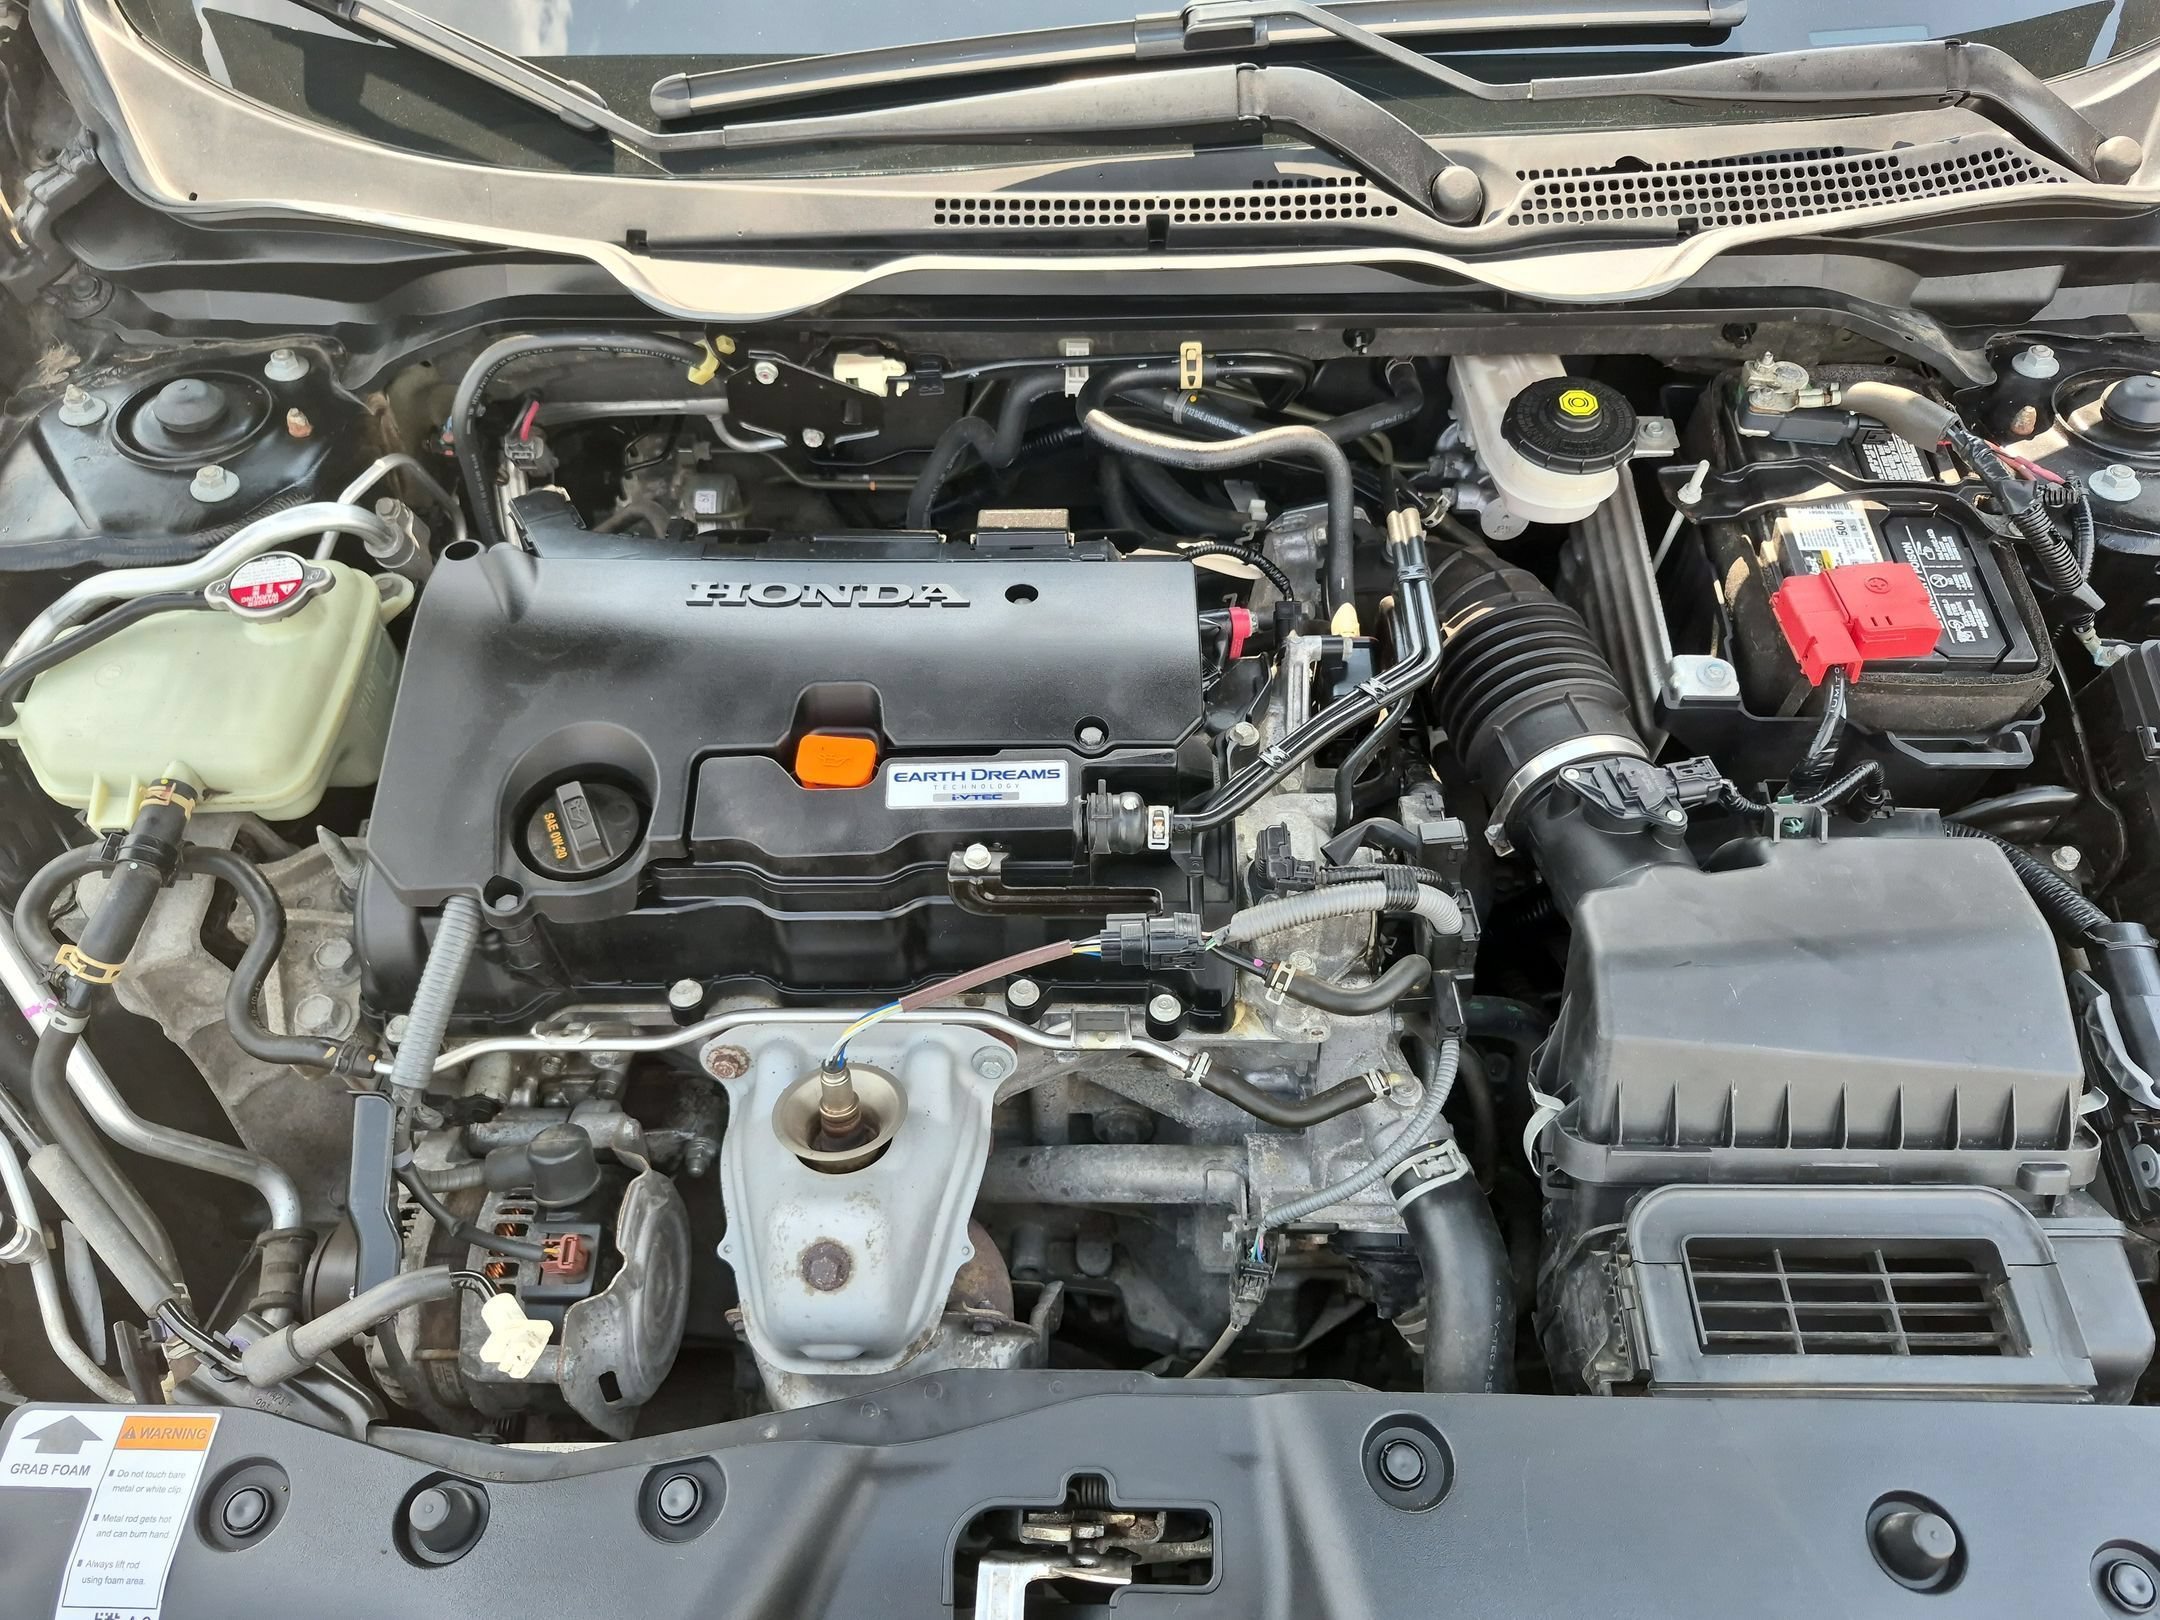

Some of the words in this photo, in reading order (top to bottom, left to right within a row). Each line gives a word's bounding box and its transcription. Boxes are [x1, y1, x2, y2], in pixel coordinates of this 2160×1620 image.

[1834, 520, 1848, 536] 500
[1901, 541, 1923, 574] POISON
[686, 582, 970, 608] HONDA
[894, 771, 965, 783] EARTH
[971, 768, 1060, 781] DREAMS
[543, 812, 559, 832] SAE
[549, 831, 568, 859] 0W-20
[140, 1427, 207, 1440] WARNING
[10, 1463, 47, 1475] GRAB
[51, 1464, 91, 1476] FOAM
[117, 1469, 130, 1478] Do
[132, 1470, 144, 1478] not
[145, 1470, 166, 1479] touch
[168, 1471, 185, 1479] bare
[112, 1485, 134, 1493] metal
[145, 1485, 165, 1493] white
[102, 1514, 124, 1523] Metal
[125, 1514, 138, 1523] rod
[139, 1516, 157, 1525] gets
[96, 1530, 111, 1538] and
[129, 1530, 148, 1538] burn
[149, 1531, 170, 1539] hand.
[85, 1560, 114, 1570] Always
[115, 1560, 125, 1568] lift
[126, 1560, 140, 1569] rod
[82, 1576, 102, 1585] using
[105, 1576, 124, 1585] foam
